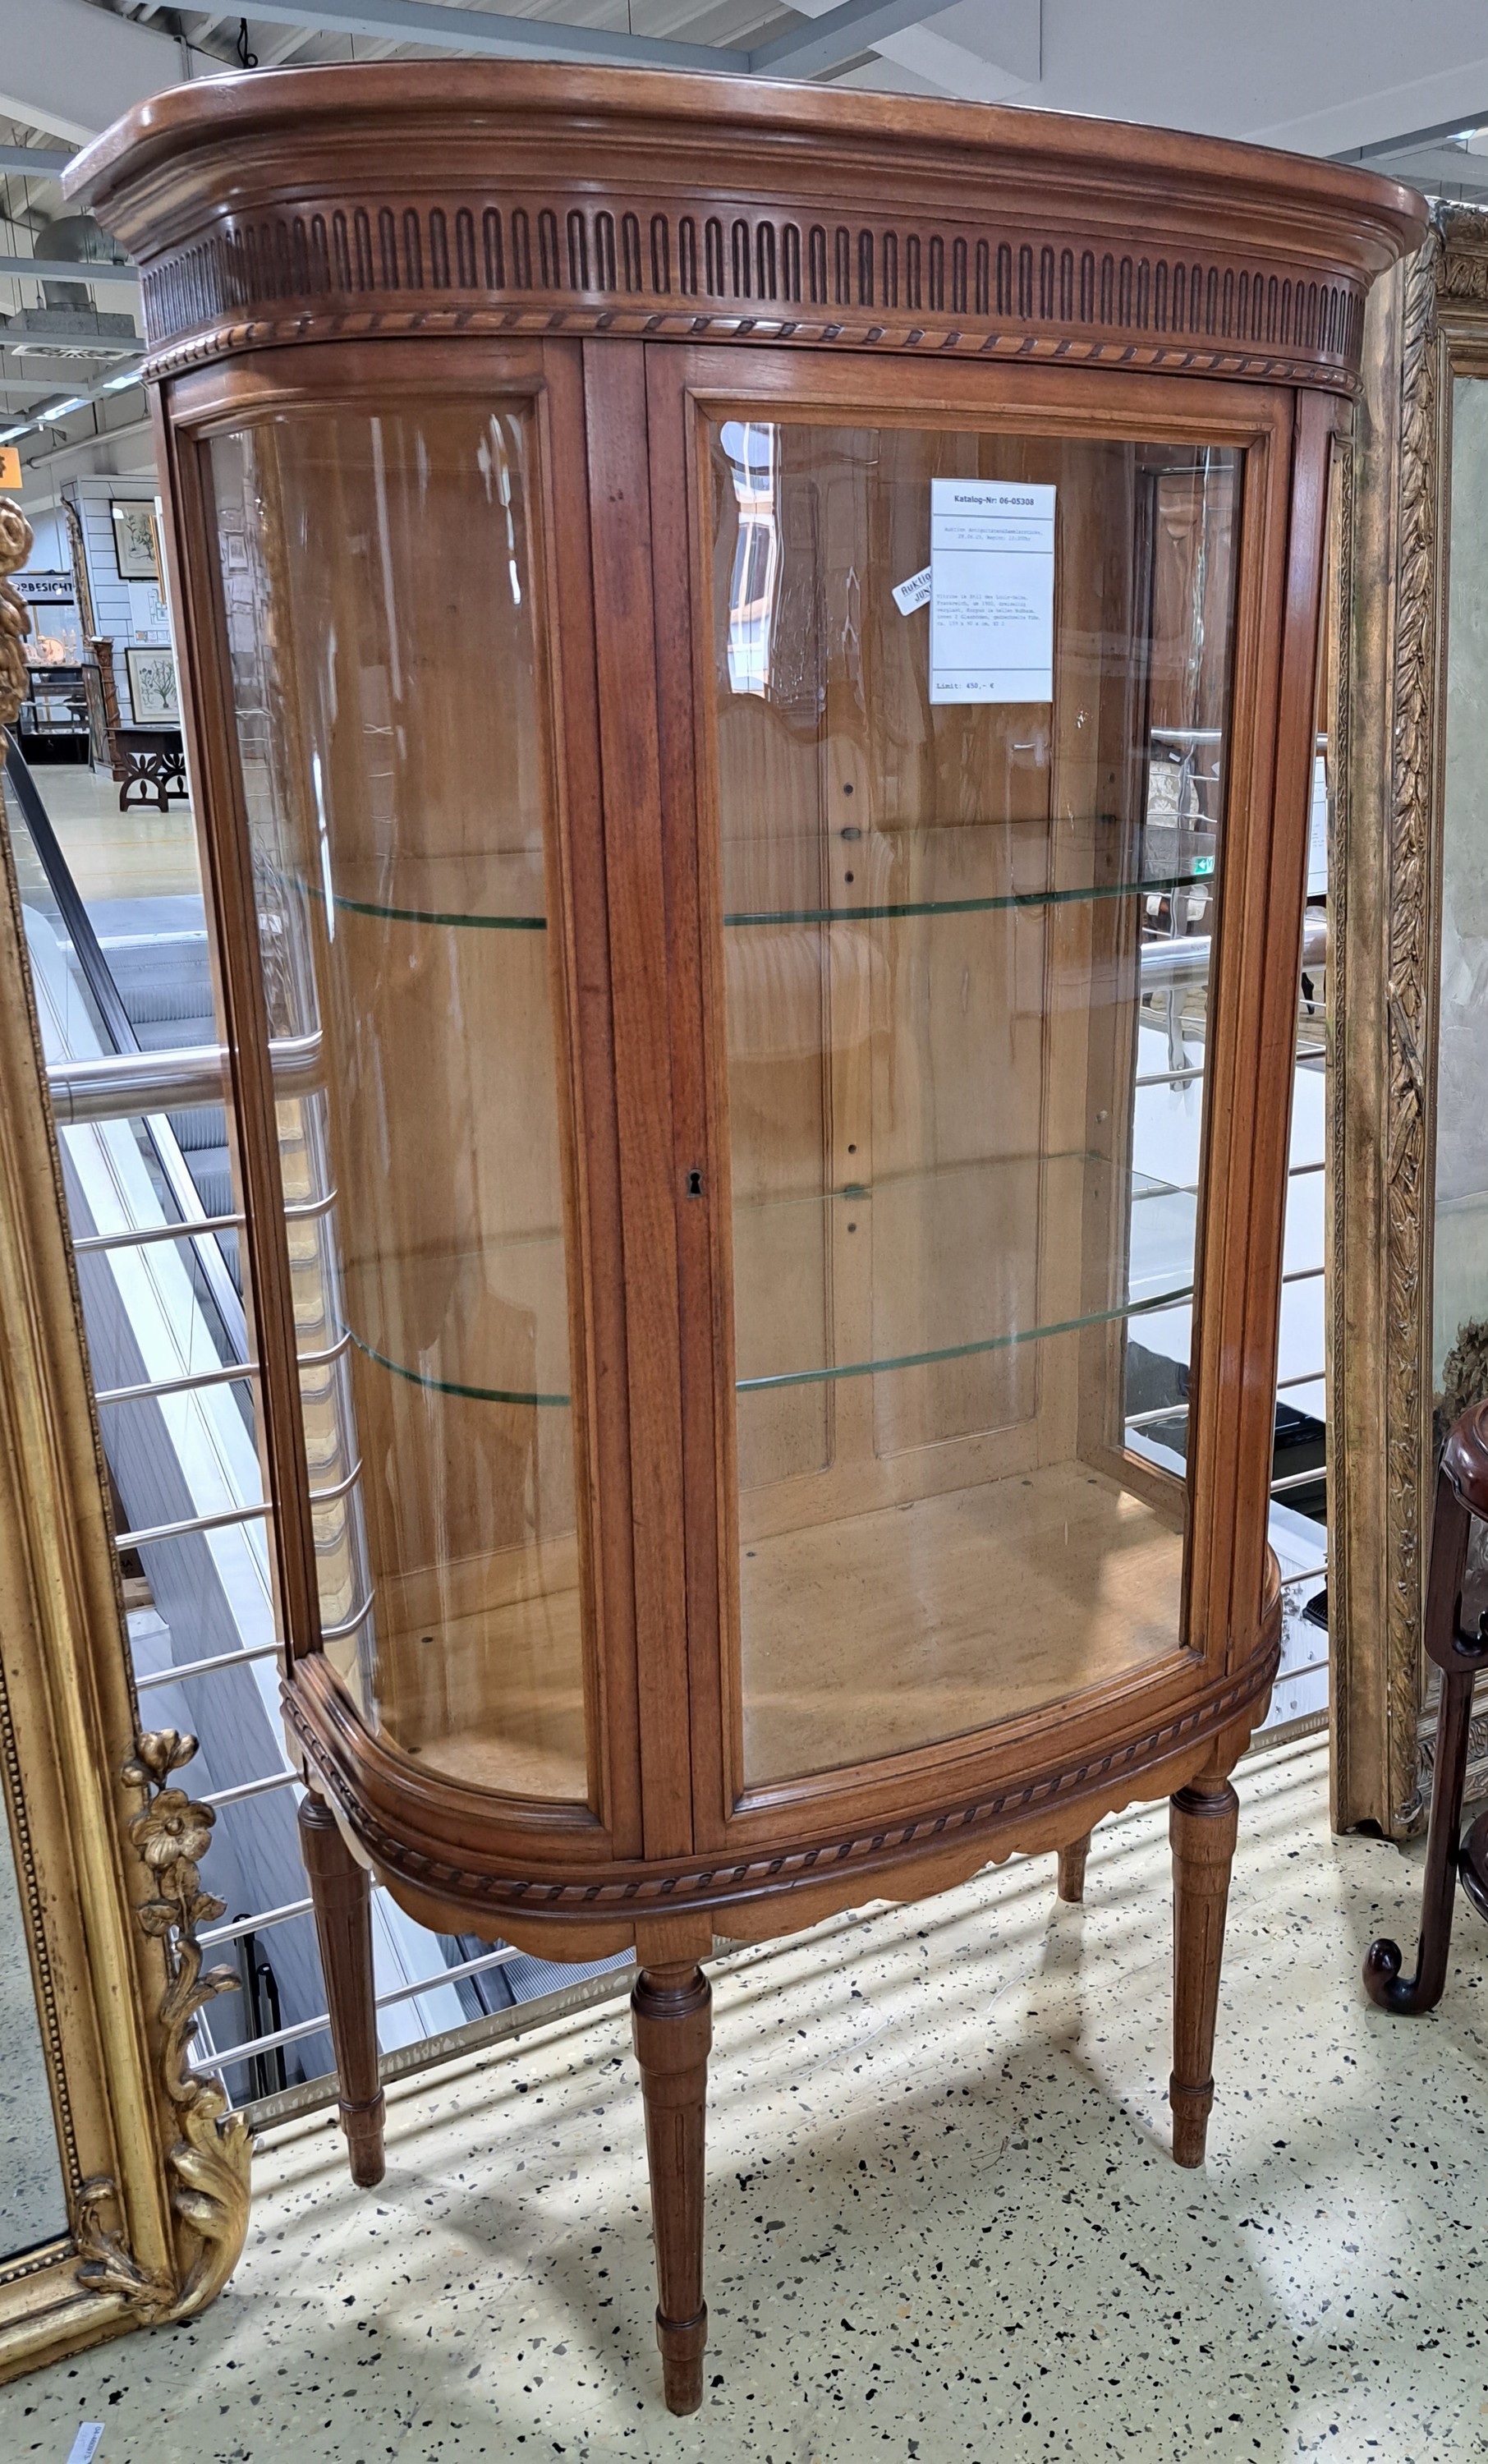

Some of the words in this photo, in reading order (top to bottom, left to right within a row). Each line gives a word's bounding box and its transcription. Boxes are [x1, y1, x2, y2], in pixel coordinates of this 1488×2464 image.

[954, 495, 997, 504] Katalog-Nr:
[999, 497, 1035, 505] 06-05308
[901, 571, 932, 595] Auktio
[915, 584, 932, 601] JUN
